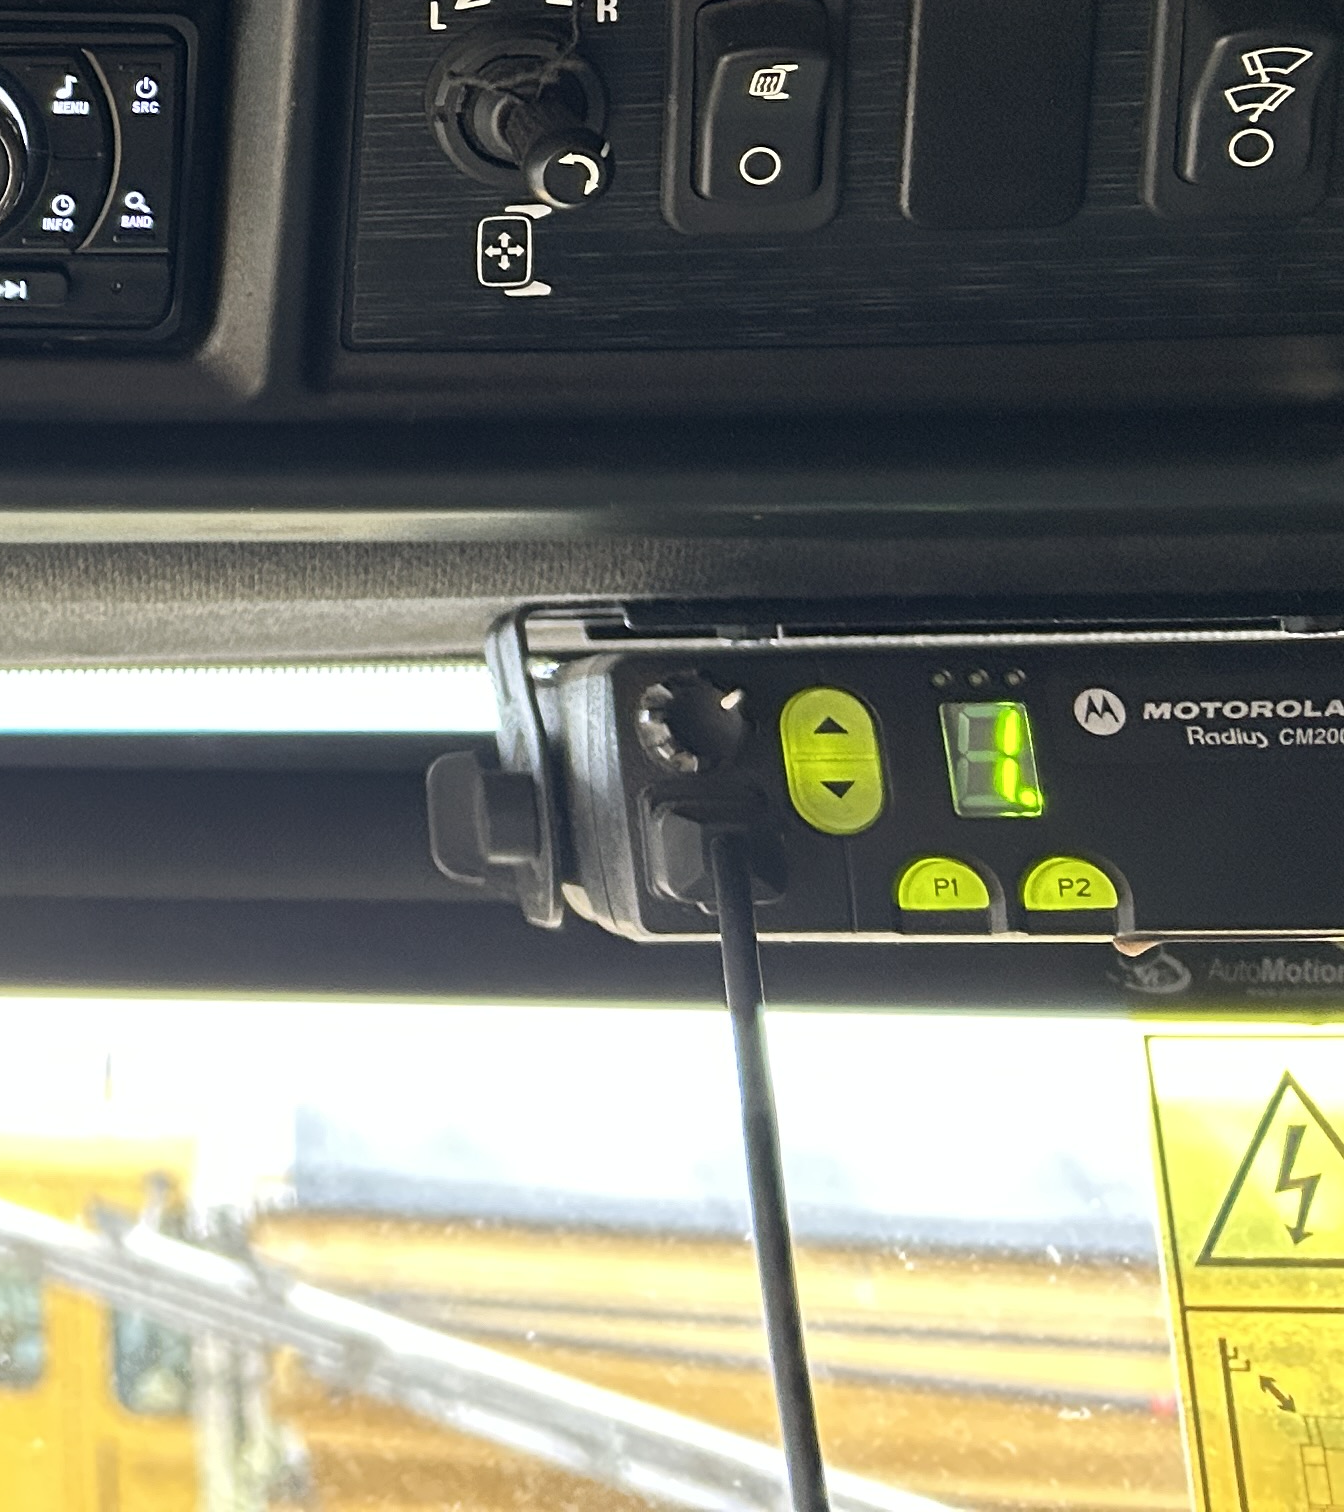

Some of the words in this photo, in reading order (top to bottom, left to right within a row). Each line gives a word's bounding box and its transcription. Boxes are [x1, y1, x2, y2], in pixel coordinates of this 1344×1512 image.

[430, 0, 448, 31] L
[52, 100, 90, 115] MENU
[131, 100, 160, 114] SRC
[42, 217, 74, 232] INFO
[120, 215, 154, 228] BAND
[1143, 699, 1344, 720] MOTOROLA
[1186, 726, 1268, 748] Radius
[934, 878, 958, 897] P1
[1058, 878, 1091, 898] P2
